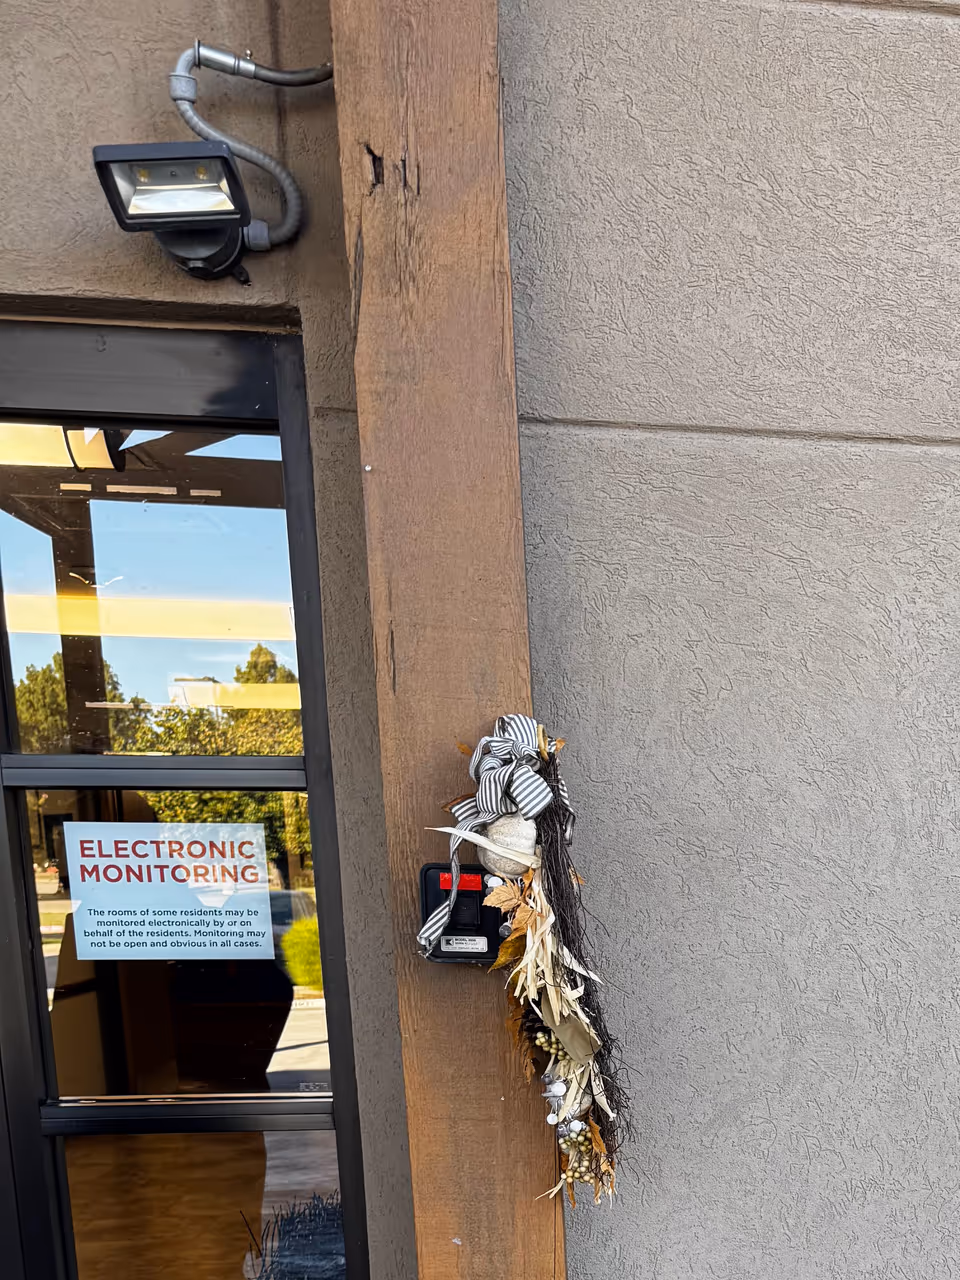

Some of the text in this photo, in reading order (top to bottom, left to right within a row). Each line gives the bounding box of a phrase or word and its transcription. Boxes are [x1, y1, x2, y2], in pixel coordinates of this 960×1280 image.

[79, 839, 256, 859] ELECTRONIC
[80, 864, 260, 883] MONITORING
[87, 908, 105, 916] The
[140, 908, 149, 916] of
[148, 919, 211, 928] electronically
[213, 919, 225, 928] by
[83, 929, 113, 937] behalf
[116, 929, 126, 937] of
[194, 930, 244, 938] Monitoring
